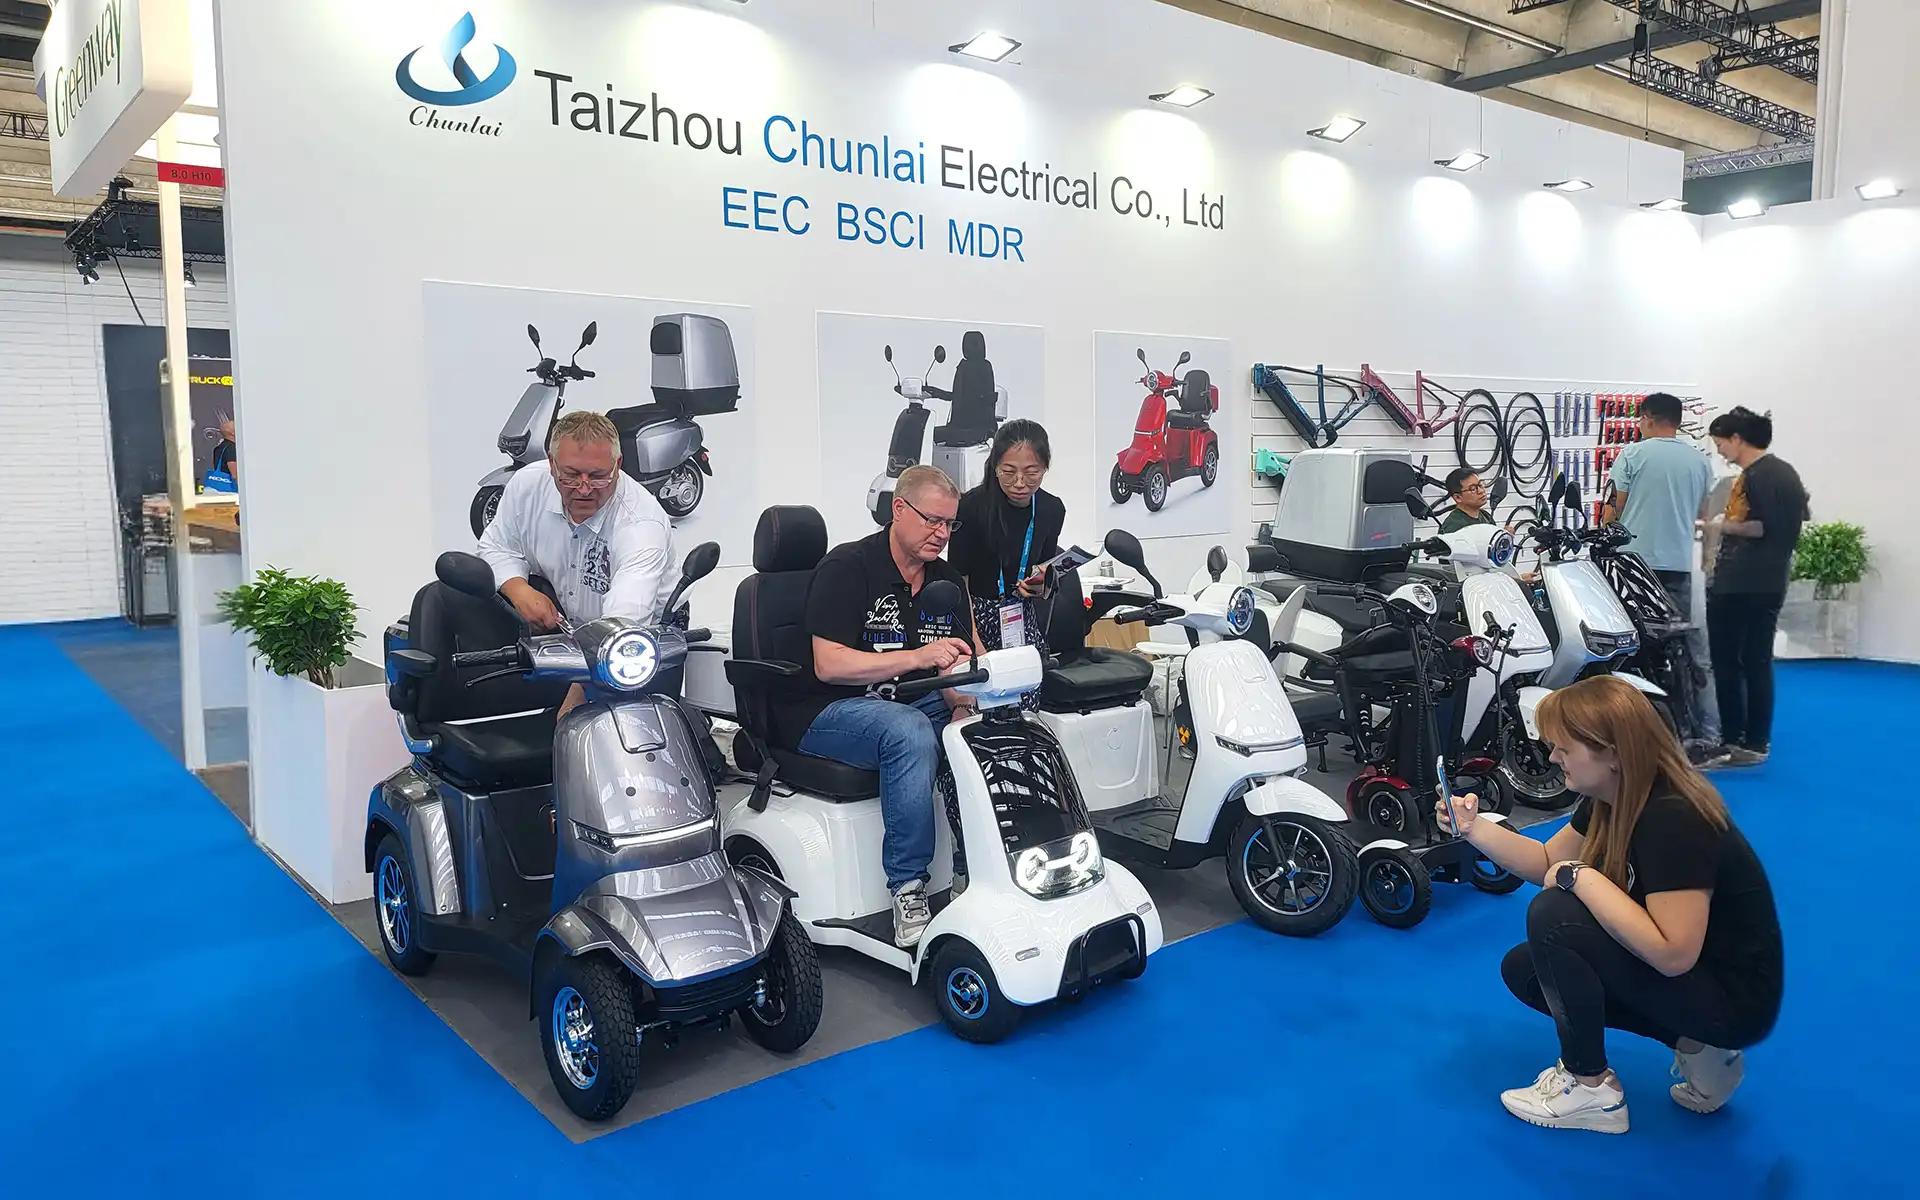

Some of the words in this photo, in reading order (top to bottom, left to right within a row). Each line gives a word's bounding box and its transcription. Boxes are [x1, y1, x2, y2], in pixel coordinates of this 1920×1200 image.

[55, 0, 122, 138] Greenway
[409, 105, 503, 137] Chunlai
[533, 69, 742, 156] Taizhou
[763, 115, 925, 185] Chunlai
[941, 144, 1098, 210] Electrical
[1110, 176, 1170, 228] Co.,
[1183, 188, 1224, 230] Ltd
[722, 186, 811, 236] EEC
[837, 202, 924, 250] BSCI
[948, 218, 1026, 263] MDR
